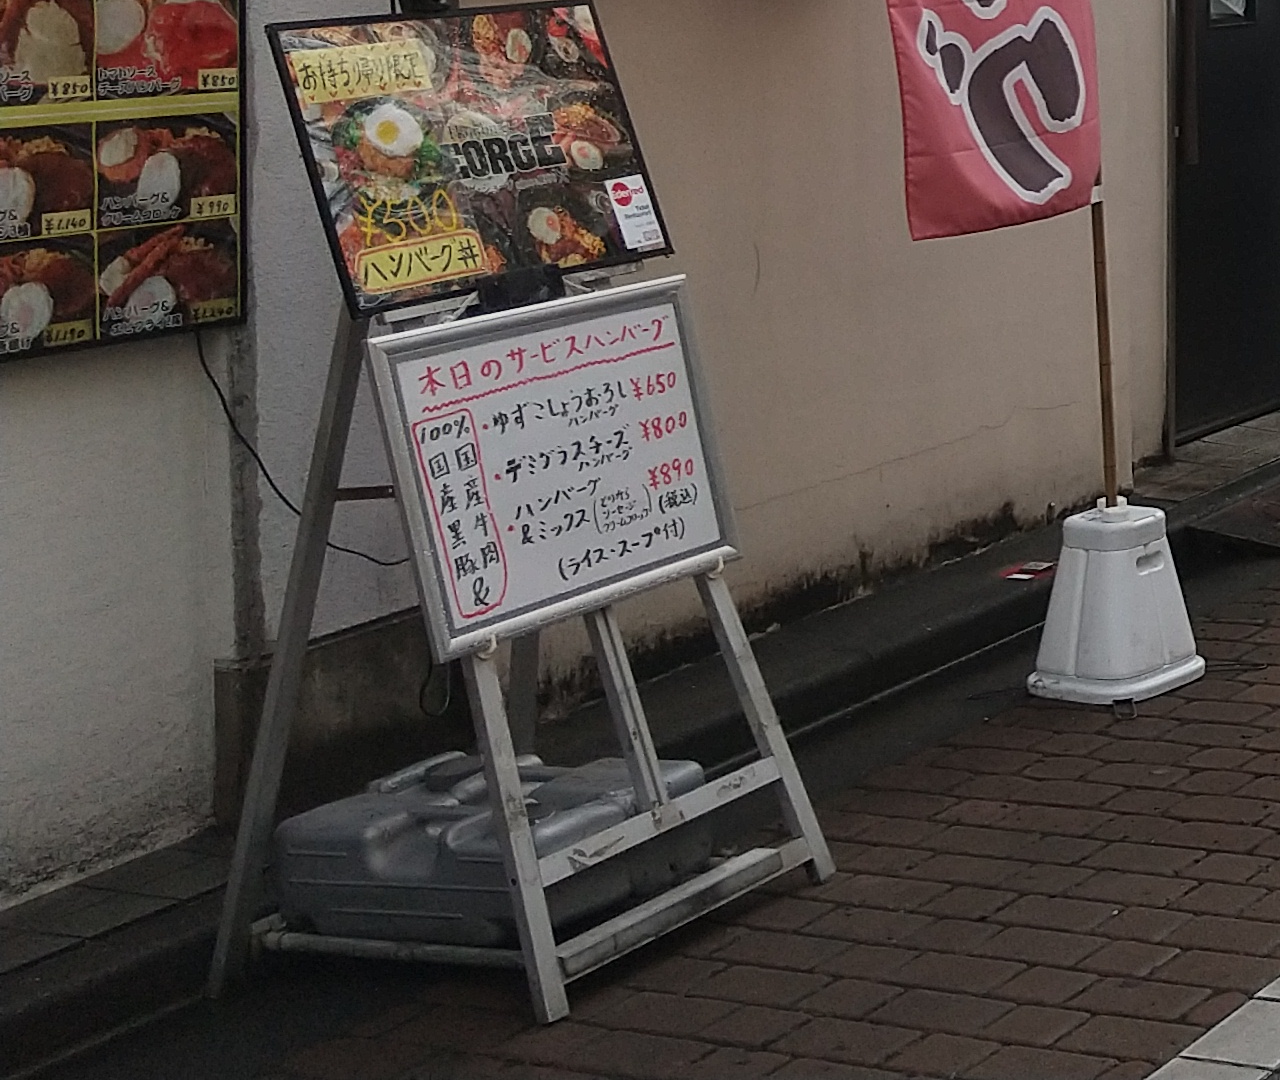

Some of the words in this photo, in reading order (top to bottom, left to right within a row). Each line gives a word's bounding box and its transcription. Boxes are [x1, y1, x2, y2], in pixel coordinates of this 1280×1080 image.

[201, 74, 238, 88] ¥850
[297, 50, 427, 93] お持ち帰り限定
[50, 80, 88, 96] ¥850
[197, 200, 230, 216] ¥990
[357, 188, 460, 248] ¥500
[362, 238, 481, 286] ハンバーグ丼
[417, 314, 670, 397] 本日のサービスハンバーグ
[631, 370, 678, 402] ¥650
[419, 414, 471, 446] 100%
[568, 403, 620, 428] ハンバーグ
[638, 410, 689, 443] ¥800
[577, 446, 635, 473] ハンバーグ
[647, 457, 696, 491] ¥890
[514, 476, 603, 520] ハンバーグ
